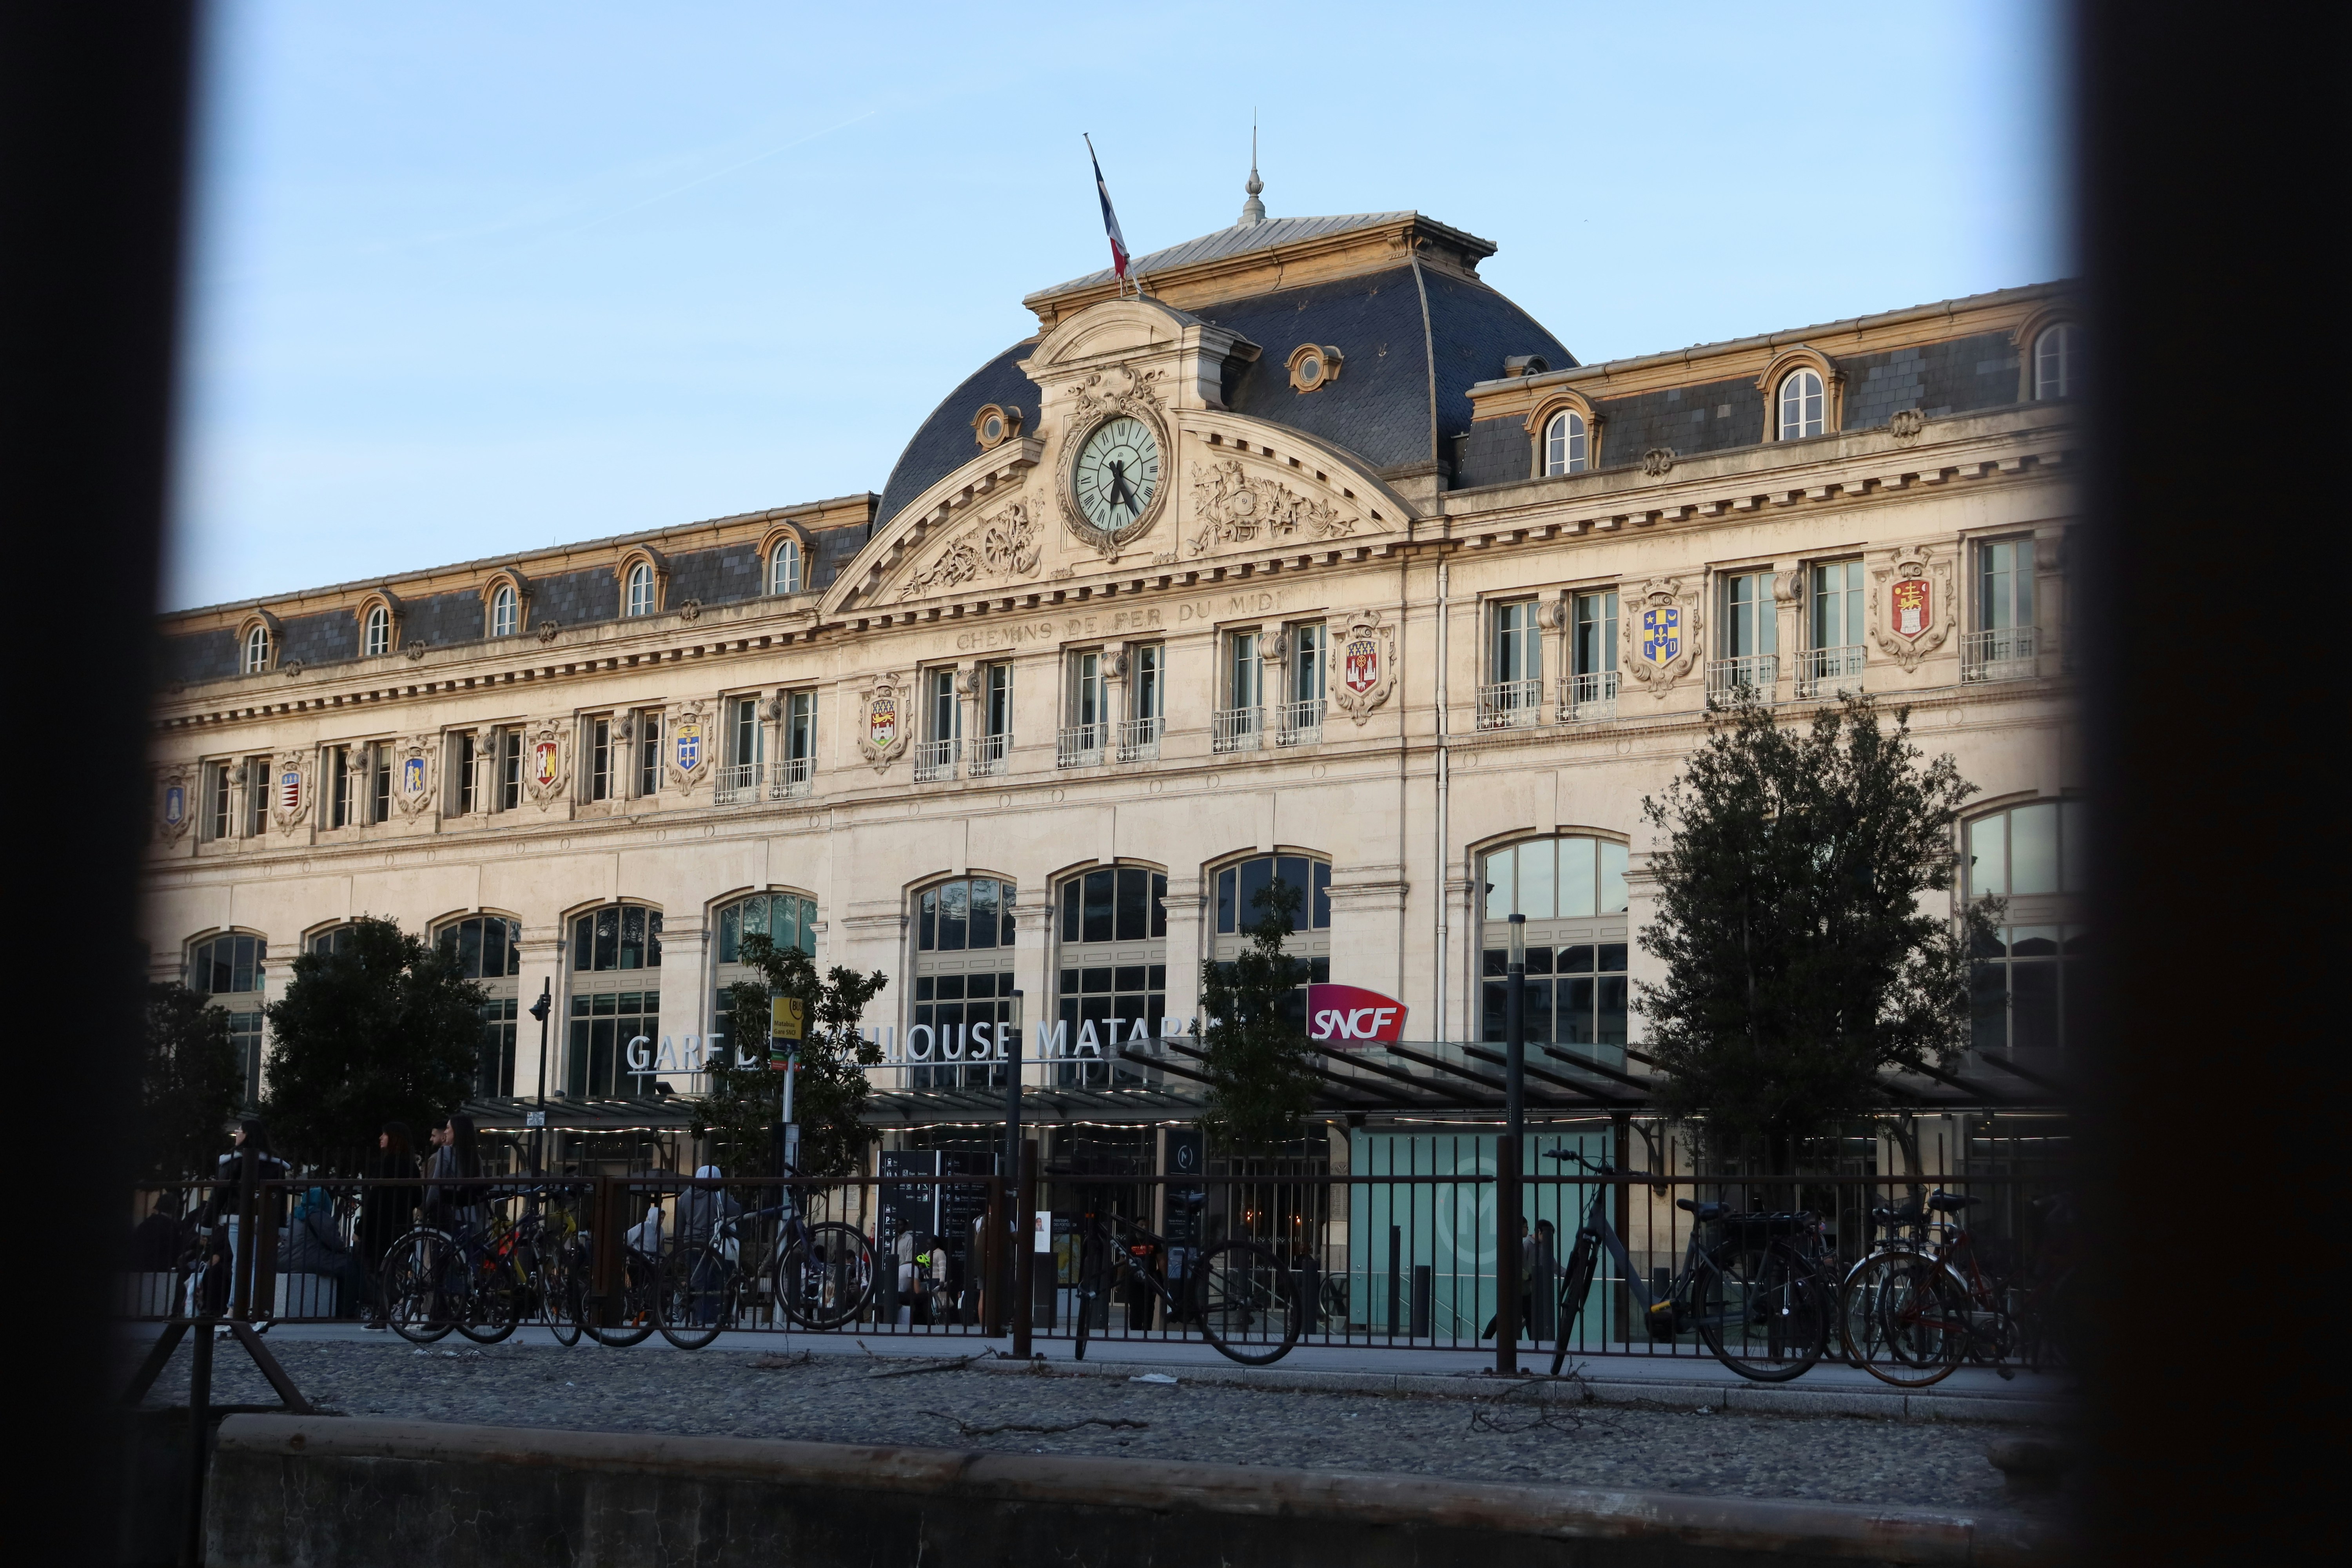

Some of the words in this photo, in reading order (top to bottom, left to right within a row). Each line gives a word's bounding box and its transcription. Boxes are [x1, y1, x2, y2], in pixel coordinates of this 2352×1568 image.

[956, 622, 1052, 650] CHEMINS
[1069, 617, 1097, 635] DE
[1114, 608, 1161, 630] FER
[1179, 601, 1211, 623] DU
[1229, 591, 1282, 615] MIDI
[1646, 643, 1653, 655] L
[1670, 641, 1676, 652] D
[792, 1000, 802, 1012] BUS
[1311, 1007, 1397, 1040] SNCF
[627, 1033, 724, 1070] GARE
